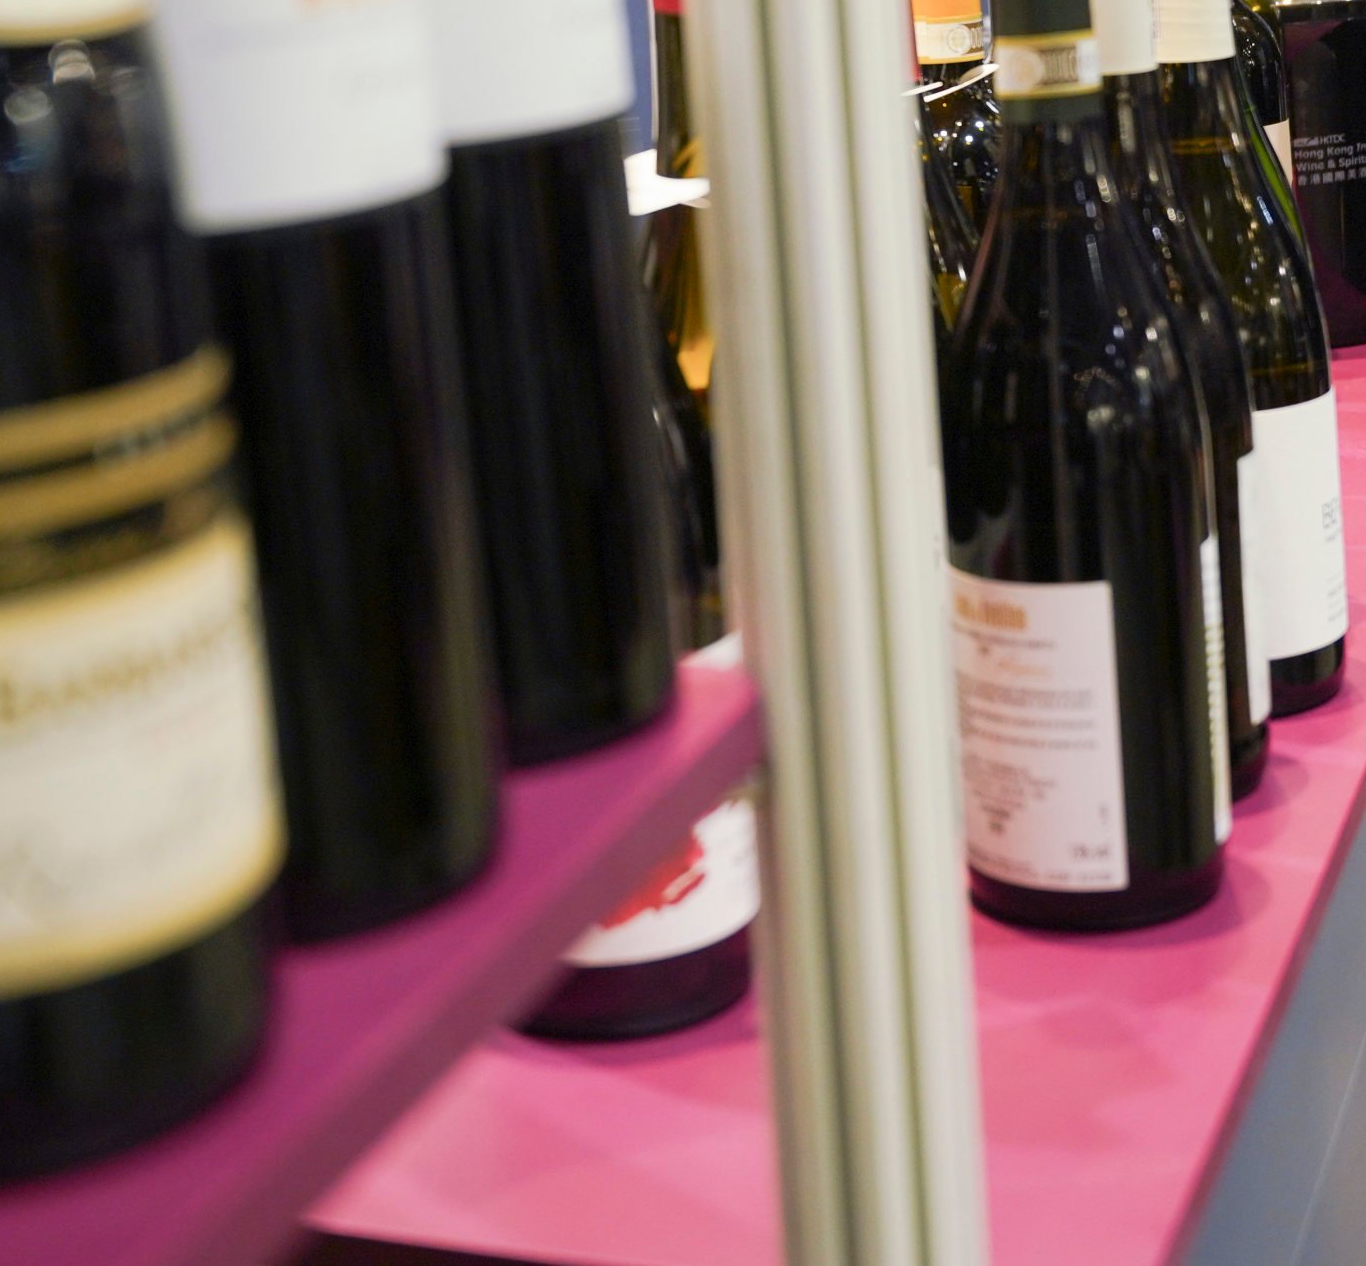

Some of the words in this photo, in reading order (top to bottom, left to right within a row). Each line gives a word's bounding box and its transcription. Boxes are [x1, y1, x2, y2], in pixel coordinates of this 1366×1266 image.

[1295, 149, 1324, 160] Hong
[1326, 145, 1354, 157] Kong
[1296, 161, 1325, 172] Wine
[1327, 159, 1336, 169] &
